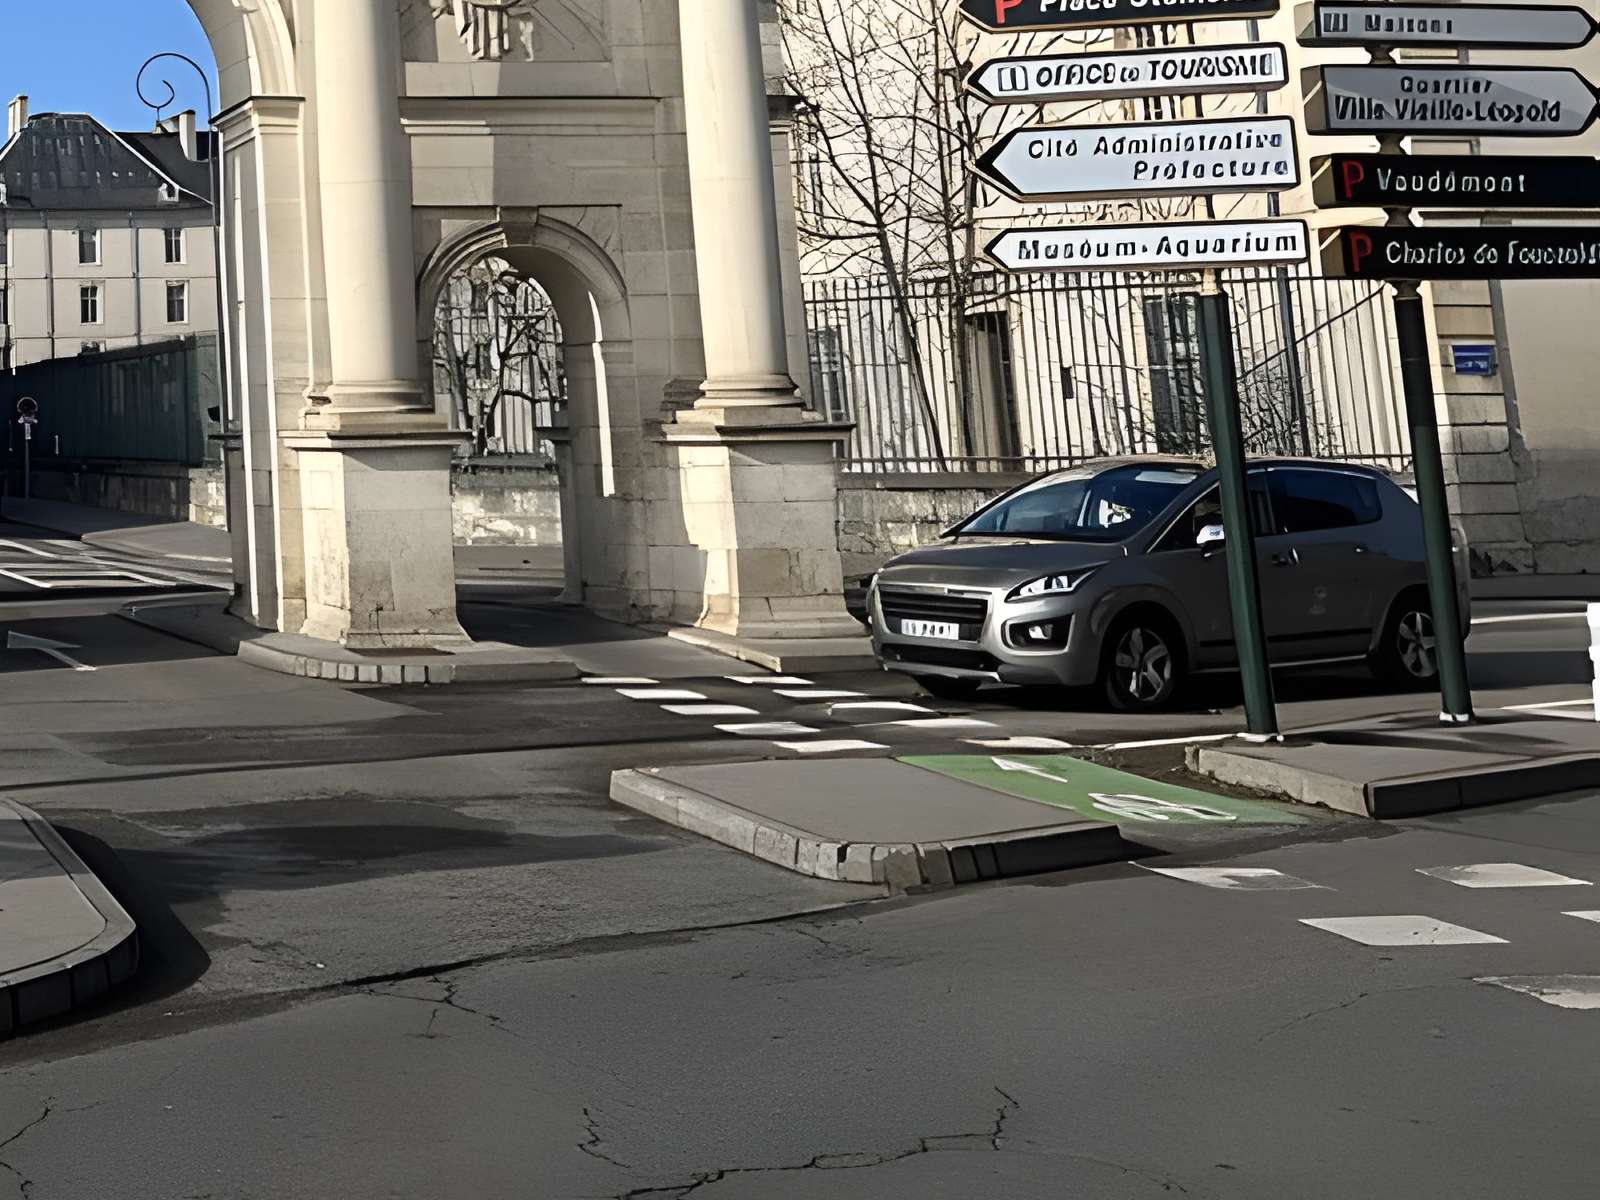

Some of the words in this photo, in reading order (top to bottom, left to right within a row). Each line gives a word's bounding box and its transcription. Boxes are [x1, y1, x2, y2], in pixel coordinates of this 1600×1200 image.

[1036, 62, 1117, 88] OFFICE
[1147, 53, 1273, 81] TOURISME
[1400, 76, 1492, 94] Quartier
[1028, 138, 1078, 159] Cité
[1093, 129, 1282, 156] Administrative
